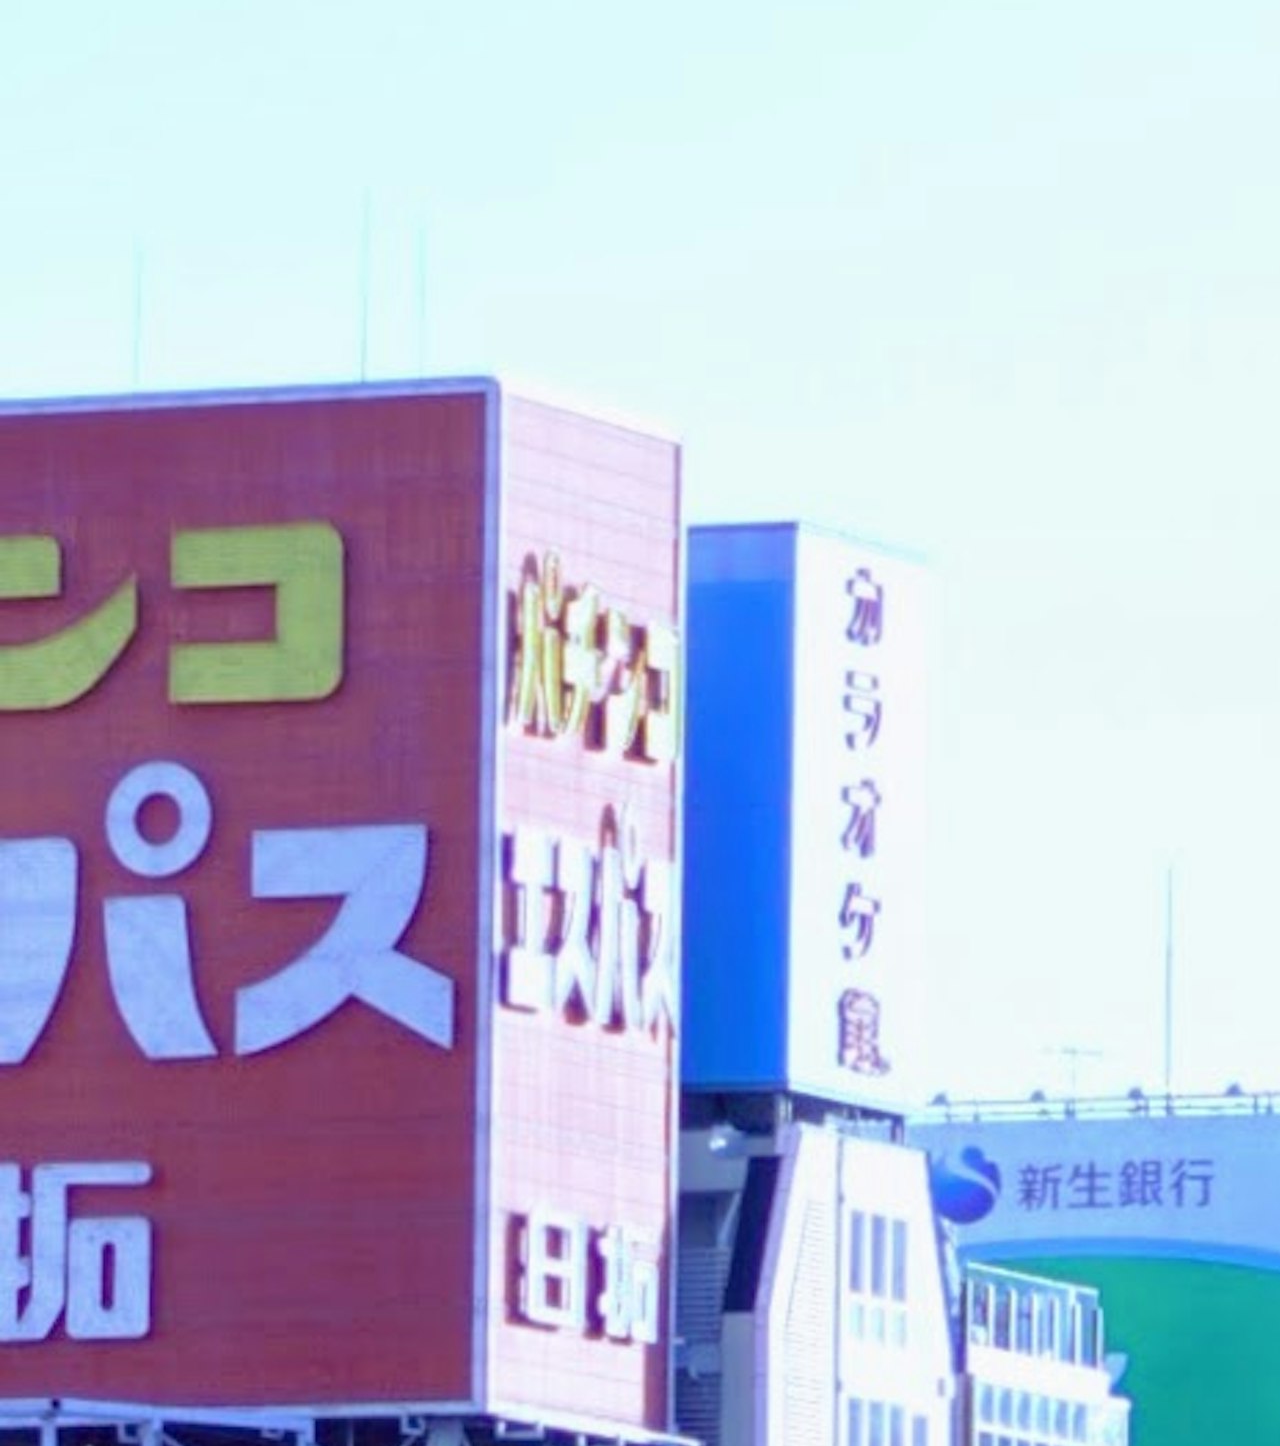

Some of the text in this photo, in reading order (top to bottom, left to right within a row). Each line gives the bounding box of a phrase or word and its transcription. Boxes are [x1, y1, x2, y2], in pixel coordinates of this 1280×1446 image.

[836, 567, 889, 1076] カラオケ館
[1016, 1157, 1215, 1212] 新生銀行
